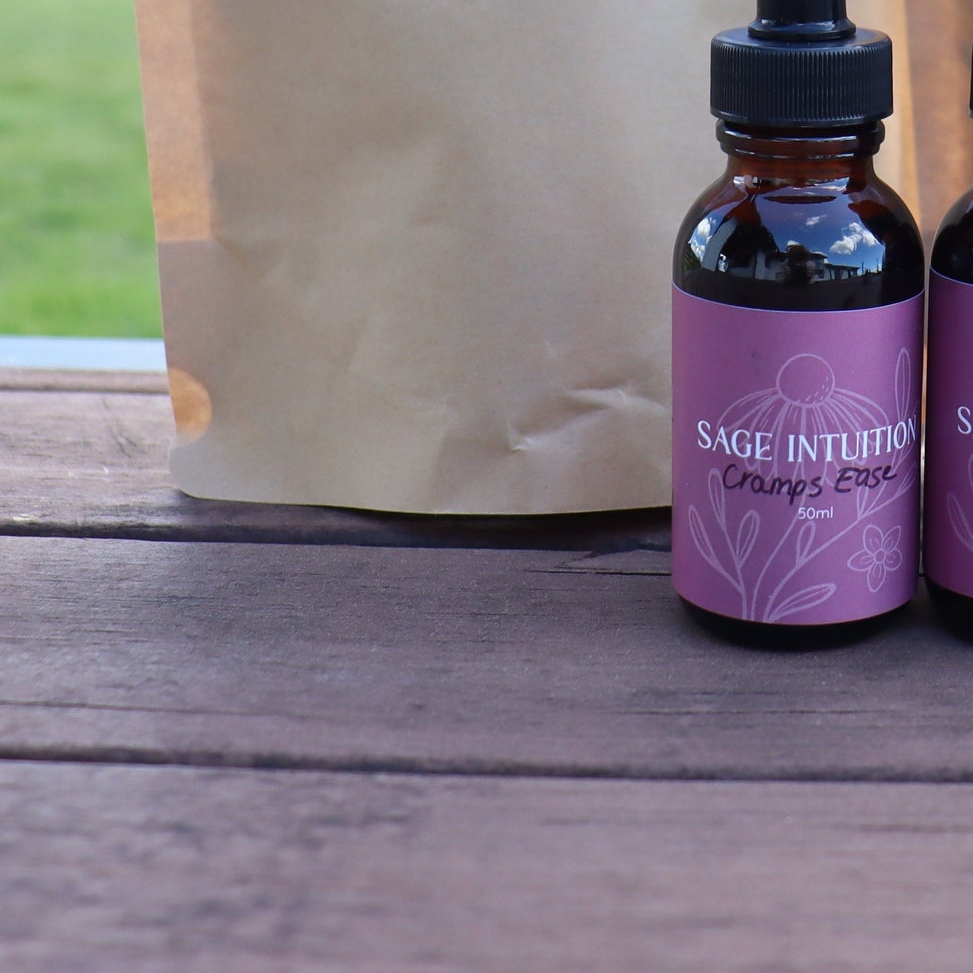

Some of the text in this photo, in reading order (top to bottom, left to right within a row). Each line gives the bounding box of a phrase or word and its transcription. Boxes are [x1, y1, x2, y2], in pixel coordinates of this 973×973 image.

[697, 415, 917, 462] SAGE INTUITION
[723, 463, 898, 507] Cramps Ease
[798, 506, 833, 520] 50ml
